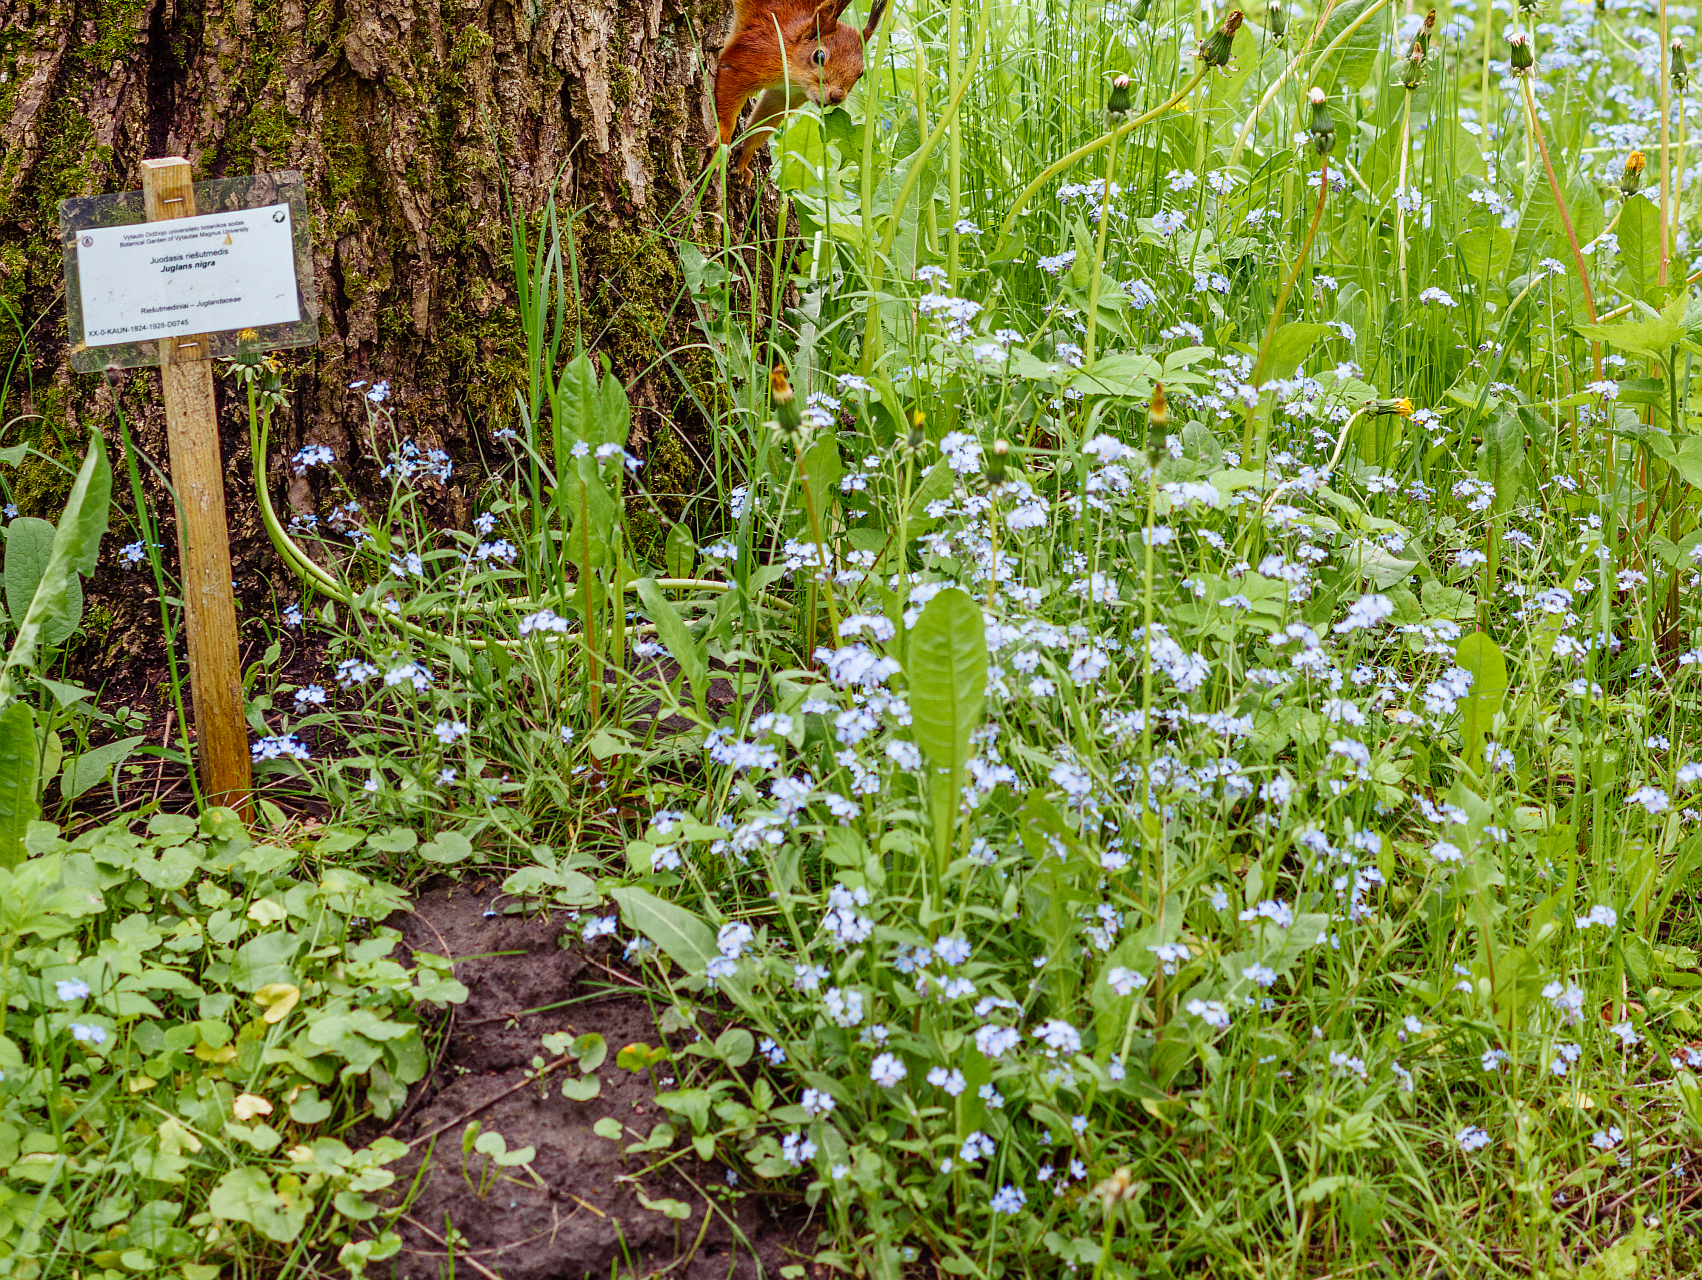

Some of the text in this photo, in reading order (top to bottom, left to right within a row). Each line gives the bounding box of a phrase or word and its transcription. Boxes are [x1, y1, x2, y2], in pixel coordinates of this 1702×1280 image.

[168, 227, 199, 235] universiteto
[174, 233, 198, 241] Vytautas
[150, 249, 228, 264] Juodasis riešutmedis
[161, 260, 215, 273] Juglans nigra
[141, 303, 189, 314] Riešutmediniai
[196, 297, 241, 308] Juglandaceae
